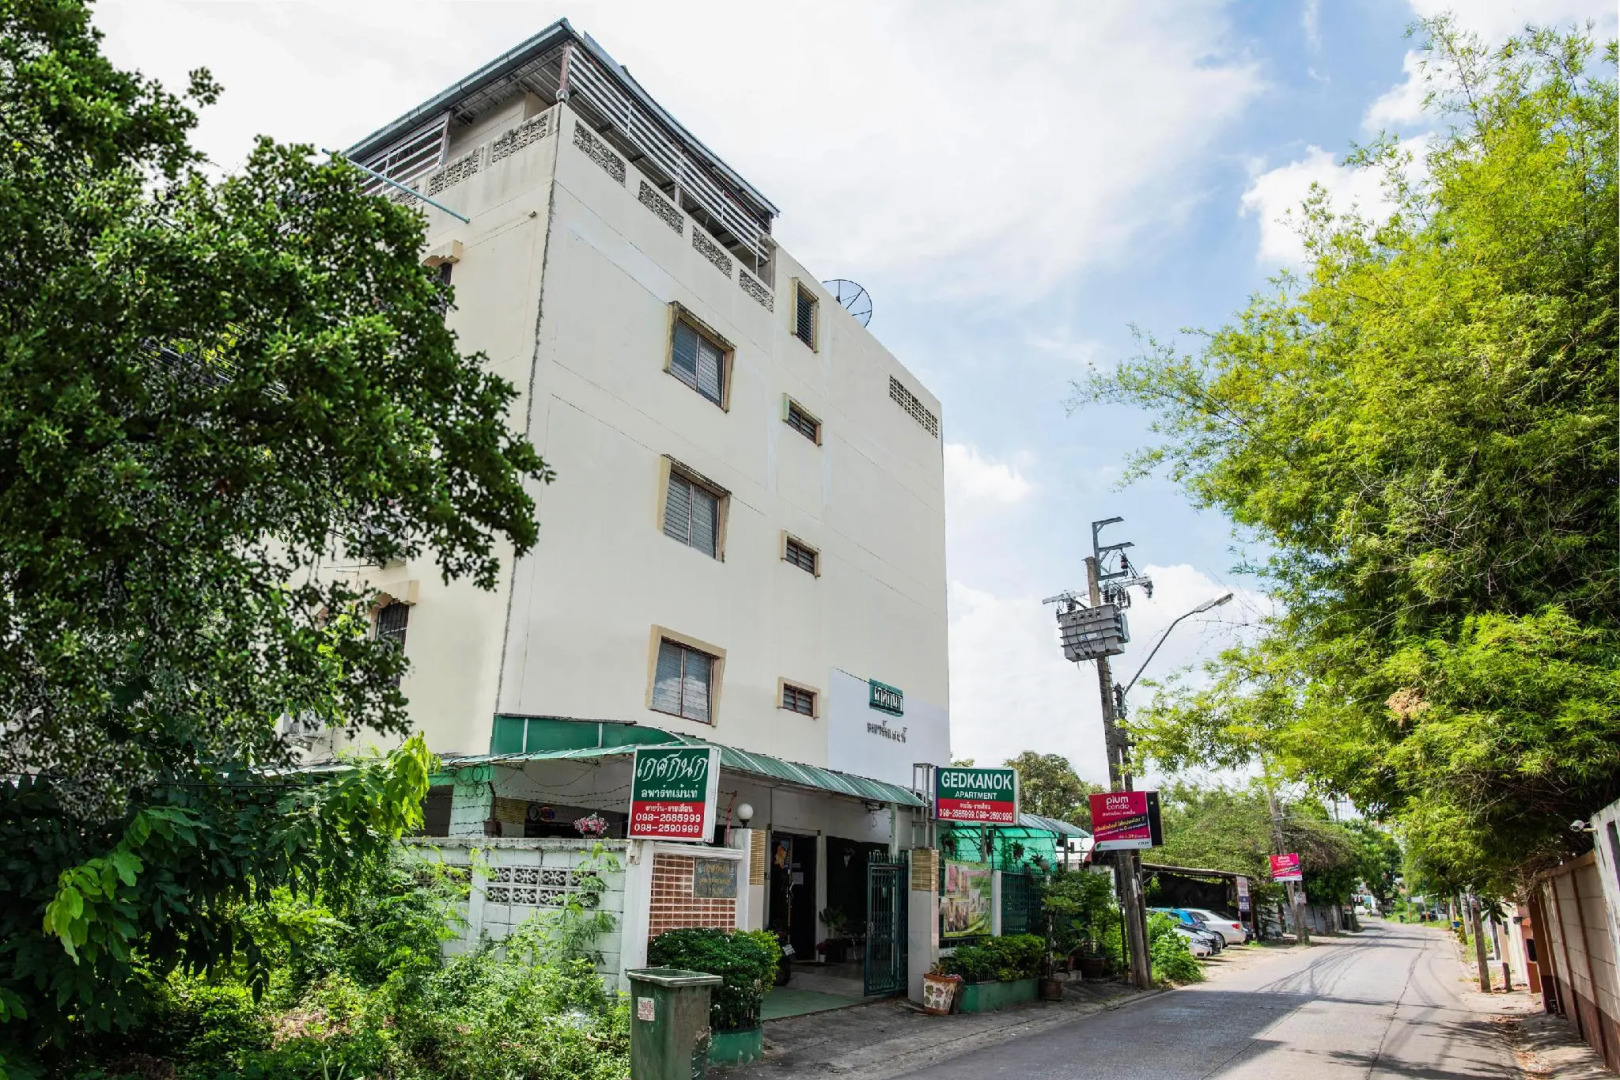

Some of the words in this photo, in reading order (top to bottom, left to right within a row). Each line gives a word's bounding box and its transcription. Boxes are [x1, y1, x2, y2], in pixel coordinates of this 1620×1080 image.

[941, 771, 1012, 790] GEDKANOK
[641, 784, 698, 798] อพาร์ทเม้นท์
[955, 791, 997, 800] APARTMENT
[1106, 796, 1129, 806] plum
